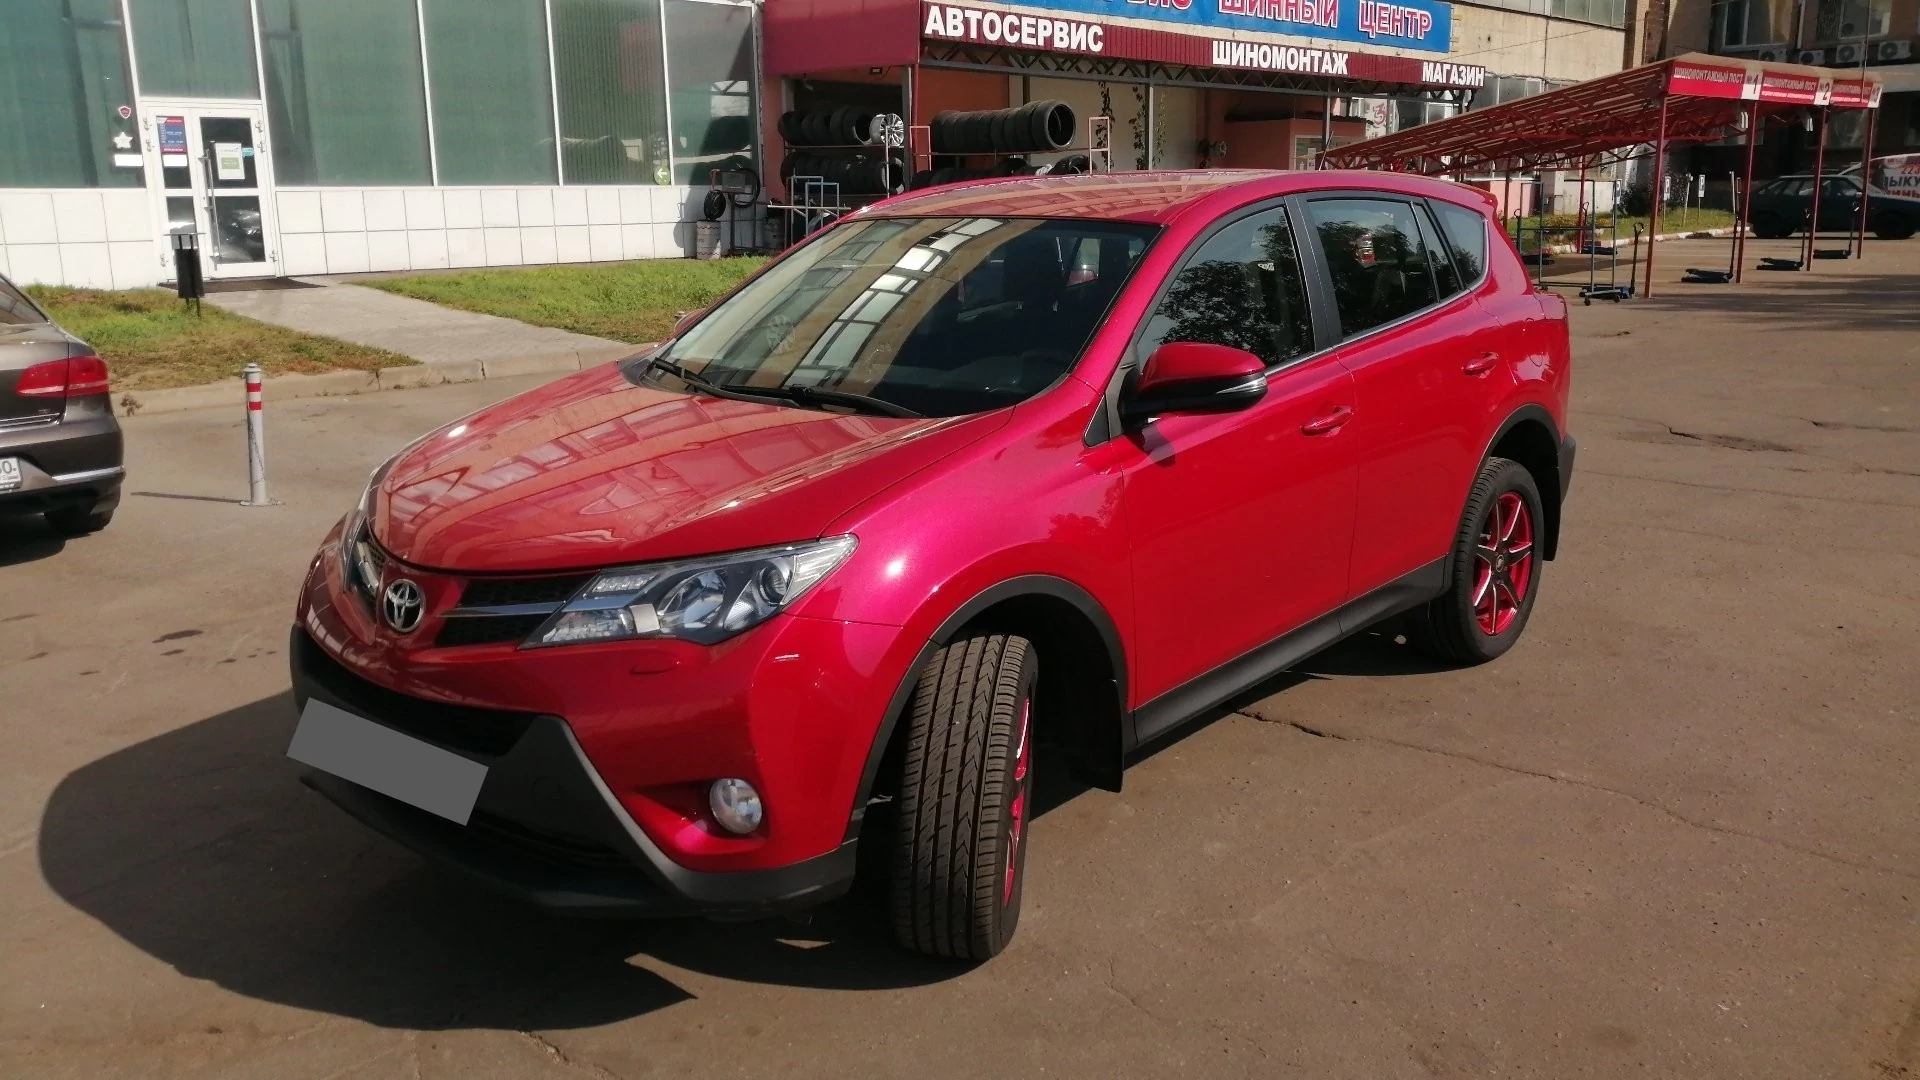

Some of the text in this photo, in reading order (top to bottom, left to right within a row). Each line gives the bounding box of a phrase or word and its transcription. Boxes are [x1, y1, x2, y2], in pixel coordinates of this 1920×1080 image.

[924, 5, 1104, 52] АВТОСЕРВИС
[1358, 1, 1432, 39] ЦЕНТР
[1212, 40, 1349, 75] ШИНОМОНТАЖ
[1421, 61, 1485, 87] МАГАЗИН
[1728, 73, 1744, 84] ПОСТ
[0, 460, 12, 474] 0
